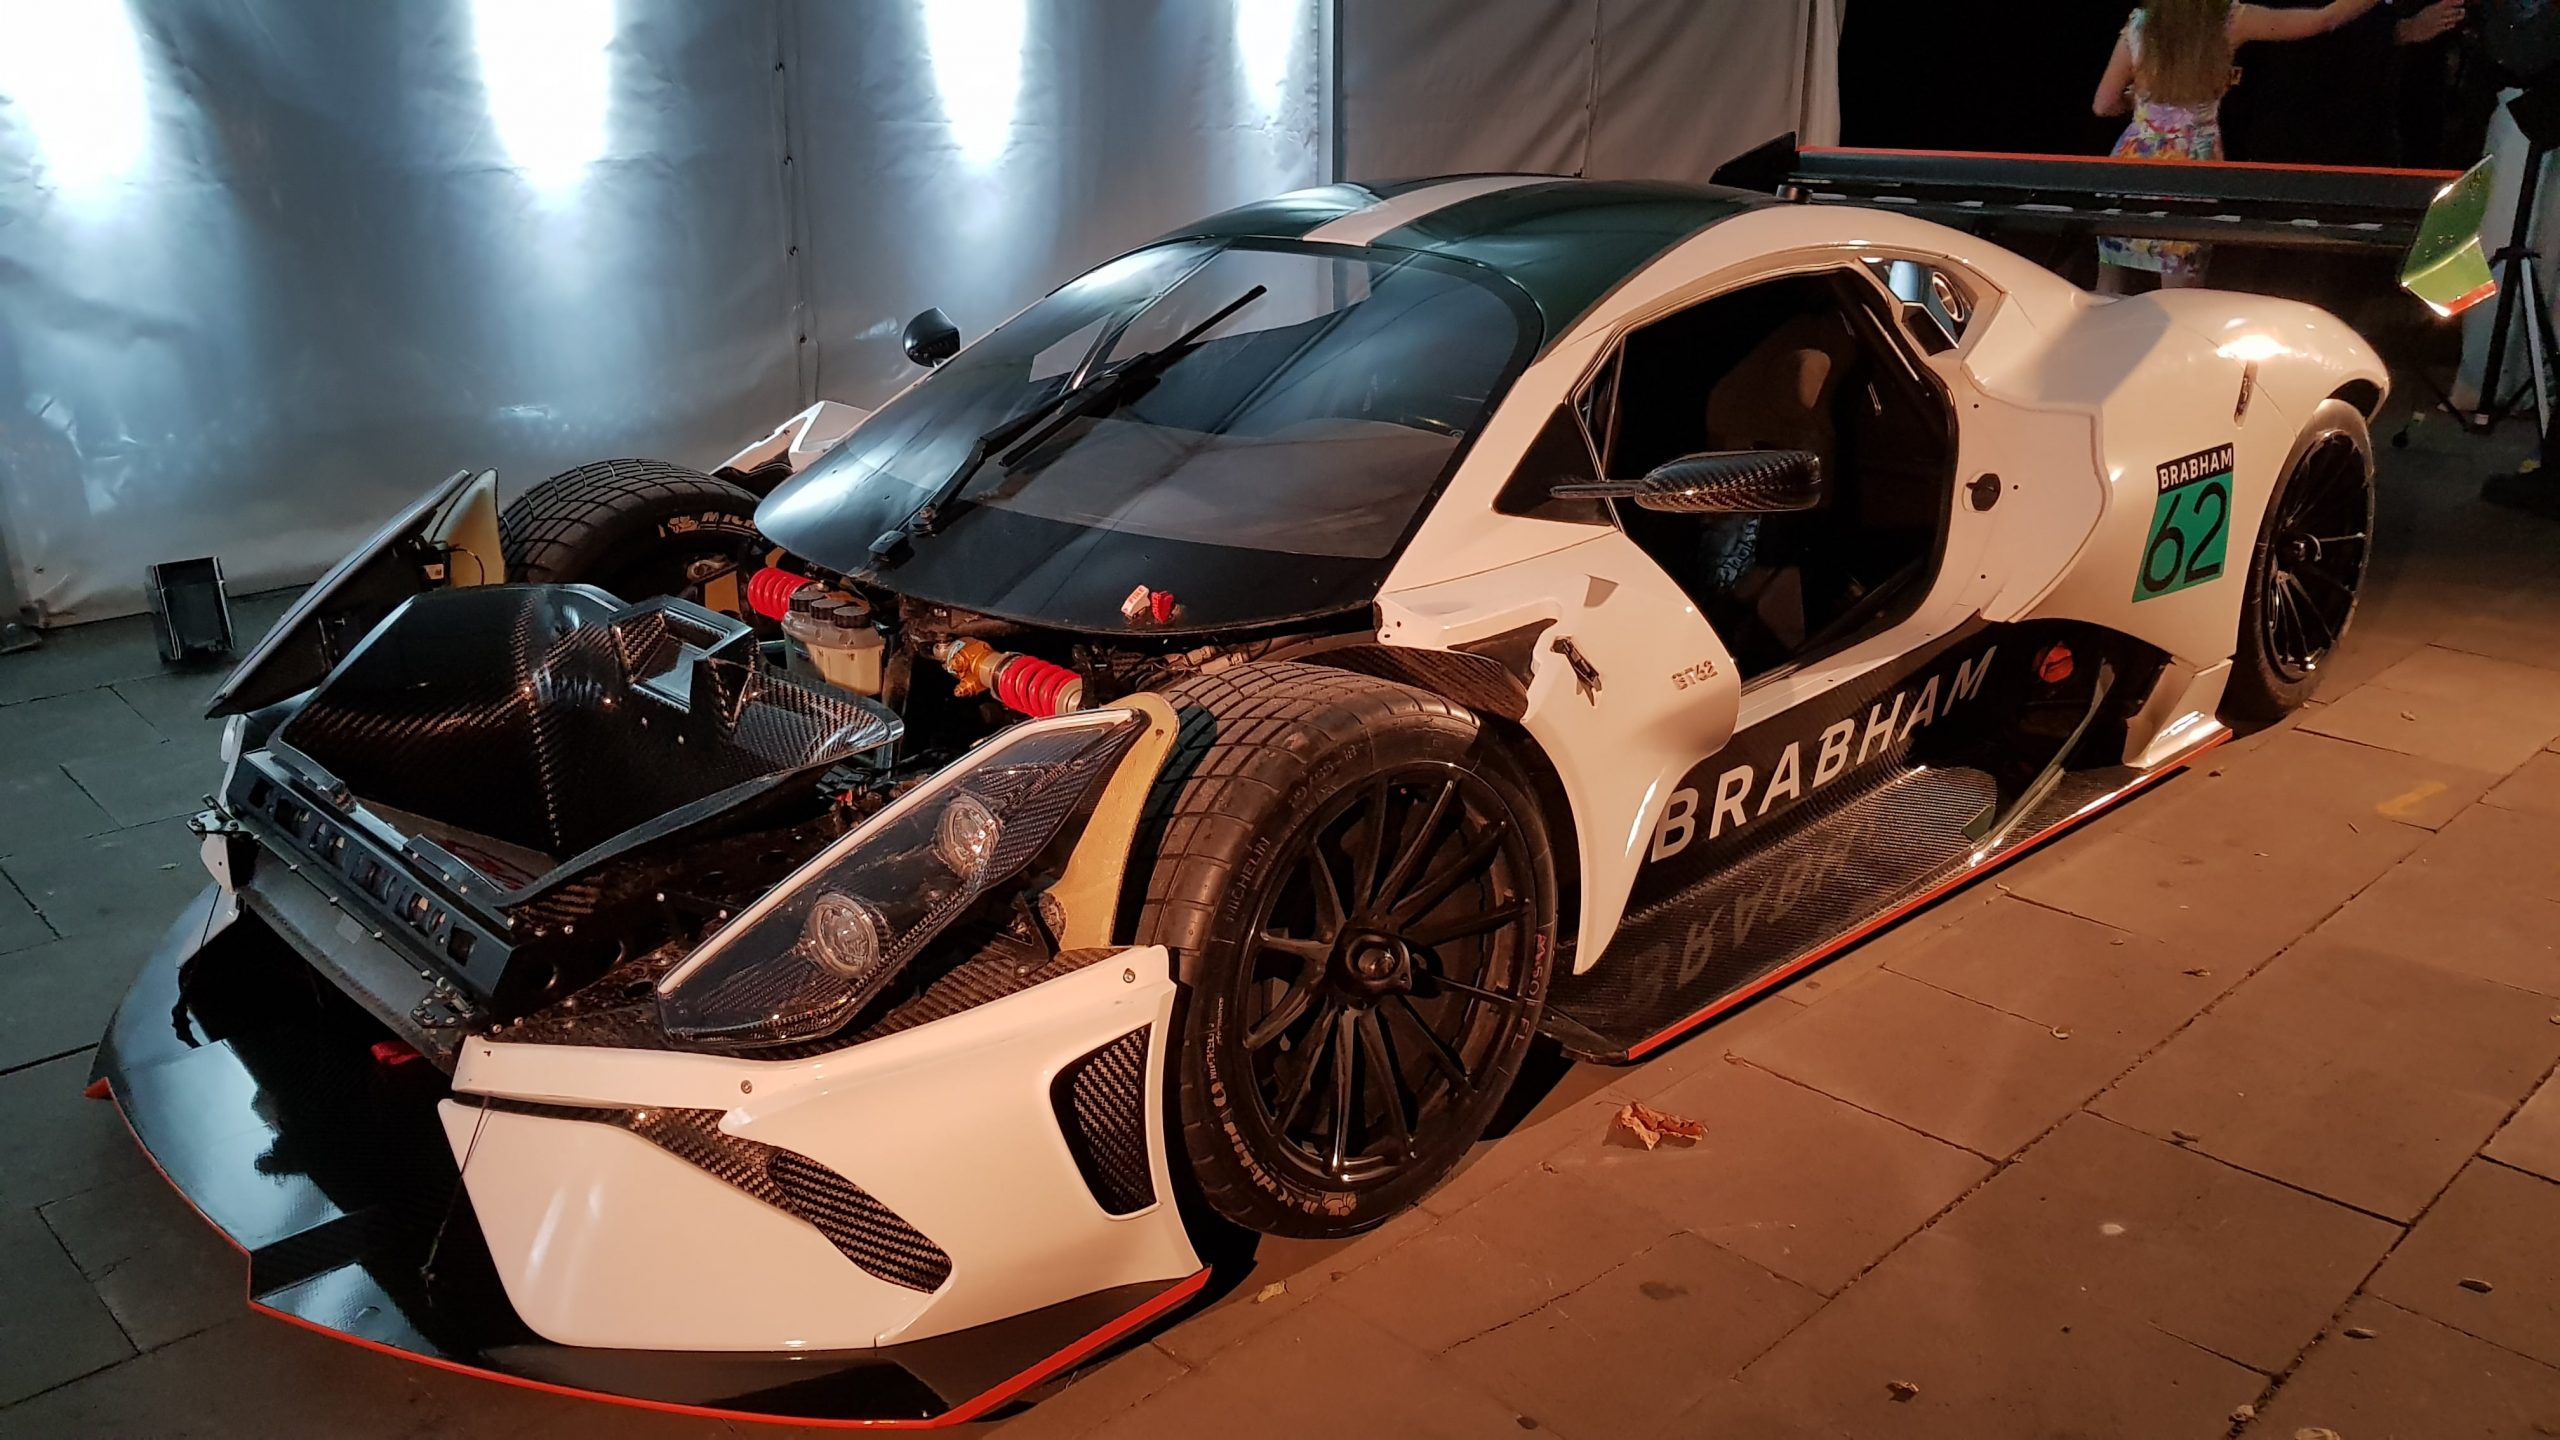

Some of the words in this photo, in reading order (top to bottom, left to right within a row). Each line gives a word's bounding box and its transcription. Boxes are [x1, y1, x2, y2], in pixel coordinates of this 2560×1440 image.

[2159, 447, 2233, 490] BRABHAM
[2142, 481, 2228, 593] 62
[1651, 646, 1998, 862] BRABHAM
